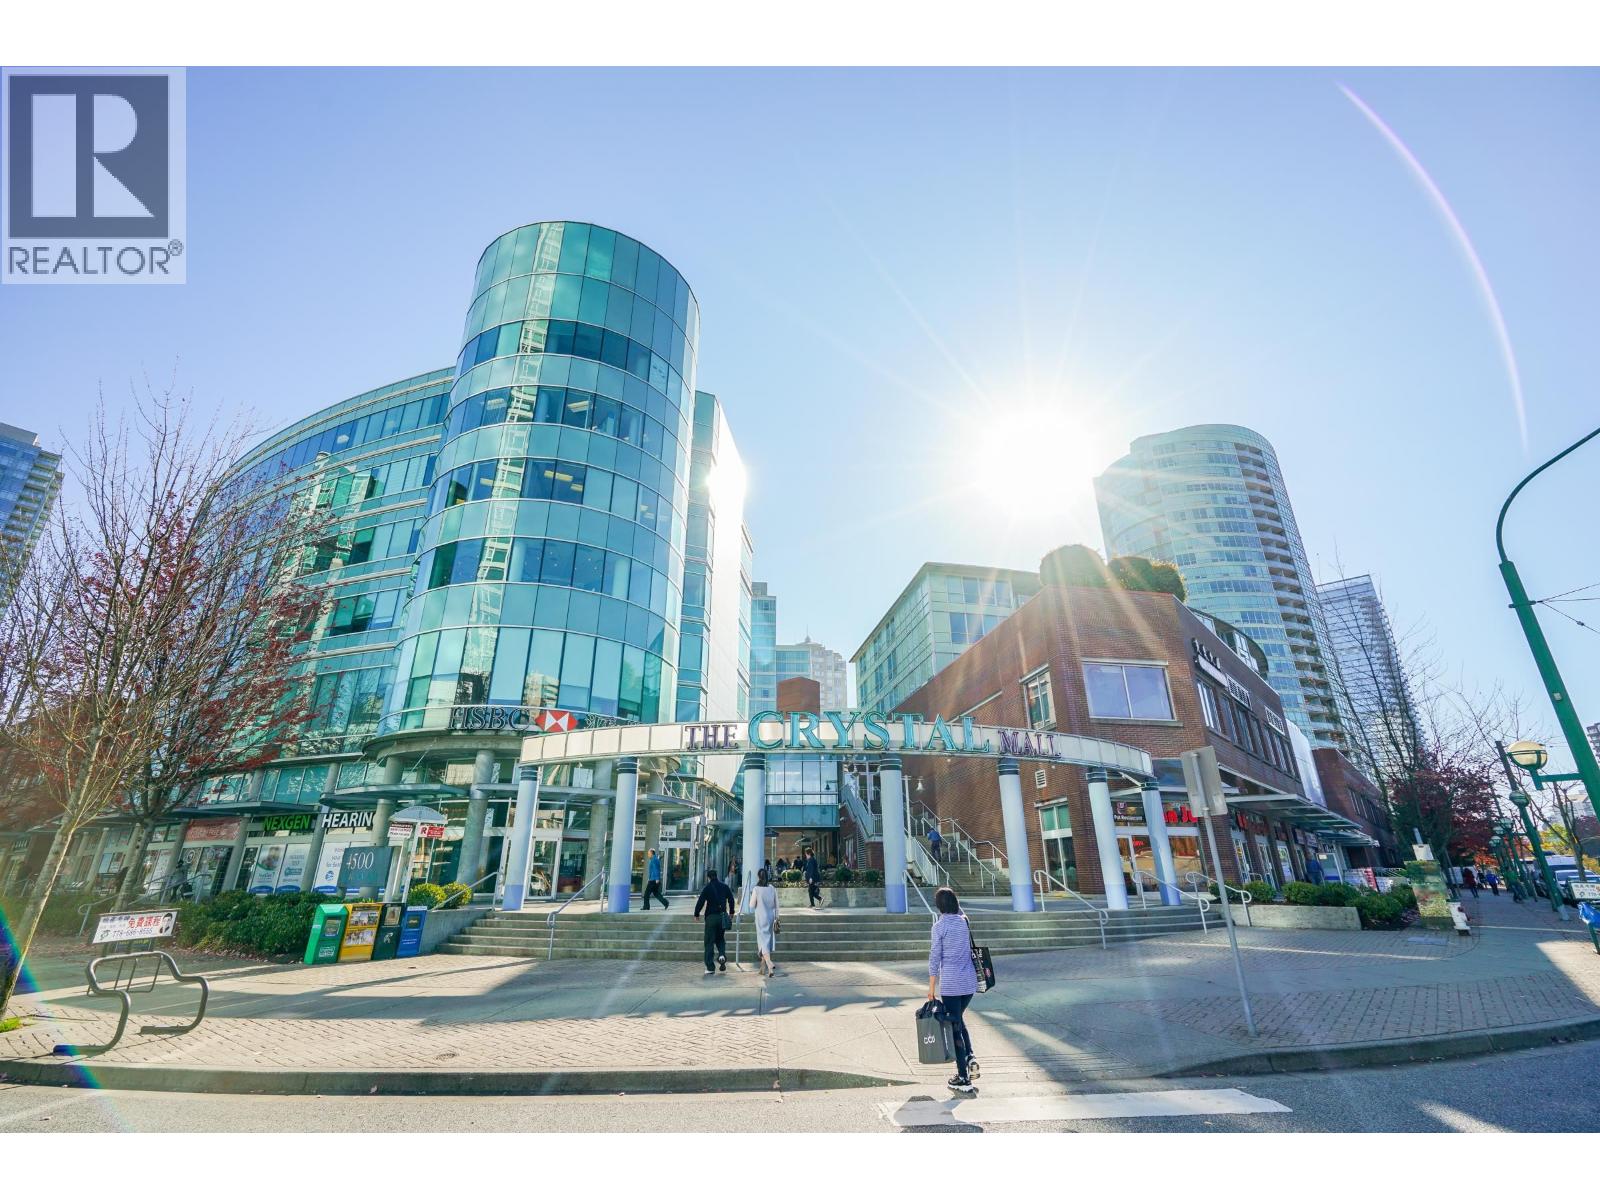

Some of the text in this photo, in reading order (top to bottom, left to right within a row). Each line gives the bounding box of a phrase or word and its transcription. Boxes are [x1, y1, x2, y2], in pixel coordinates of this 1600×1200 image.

[449, 706, 530, 730] HSBC
[685, 710, 1062, 759] THE CRYSTAL MALL
[263, 811, 374, 831] NEXGEN HEARIN
[346, 851, 374, 870] 4500
